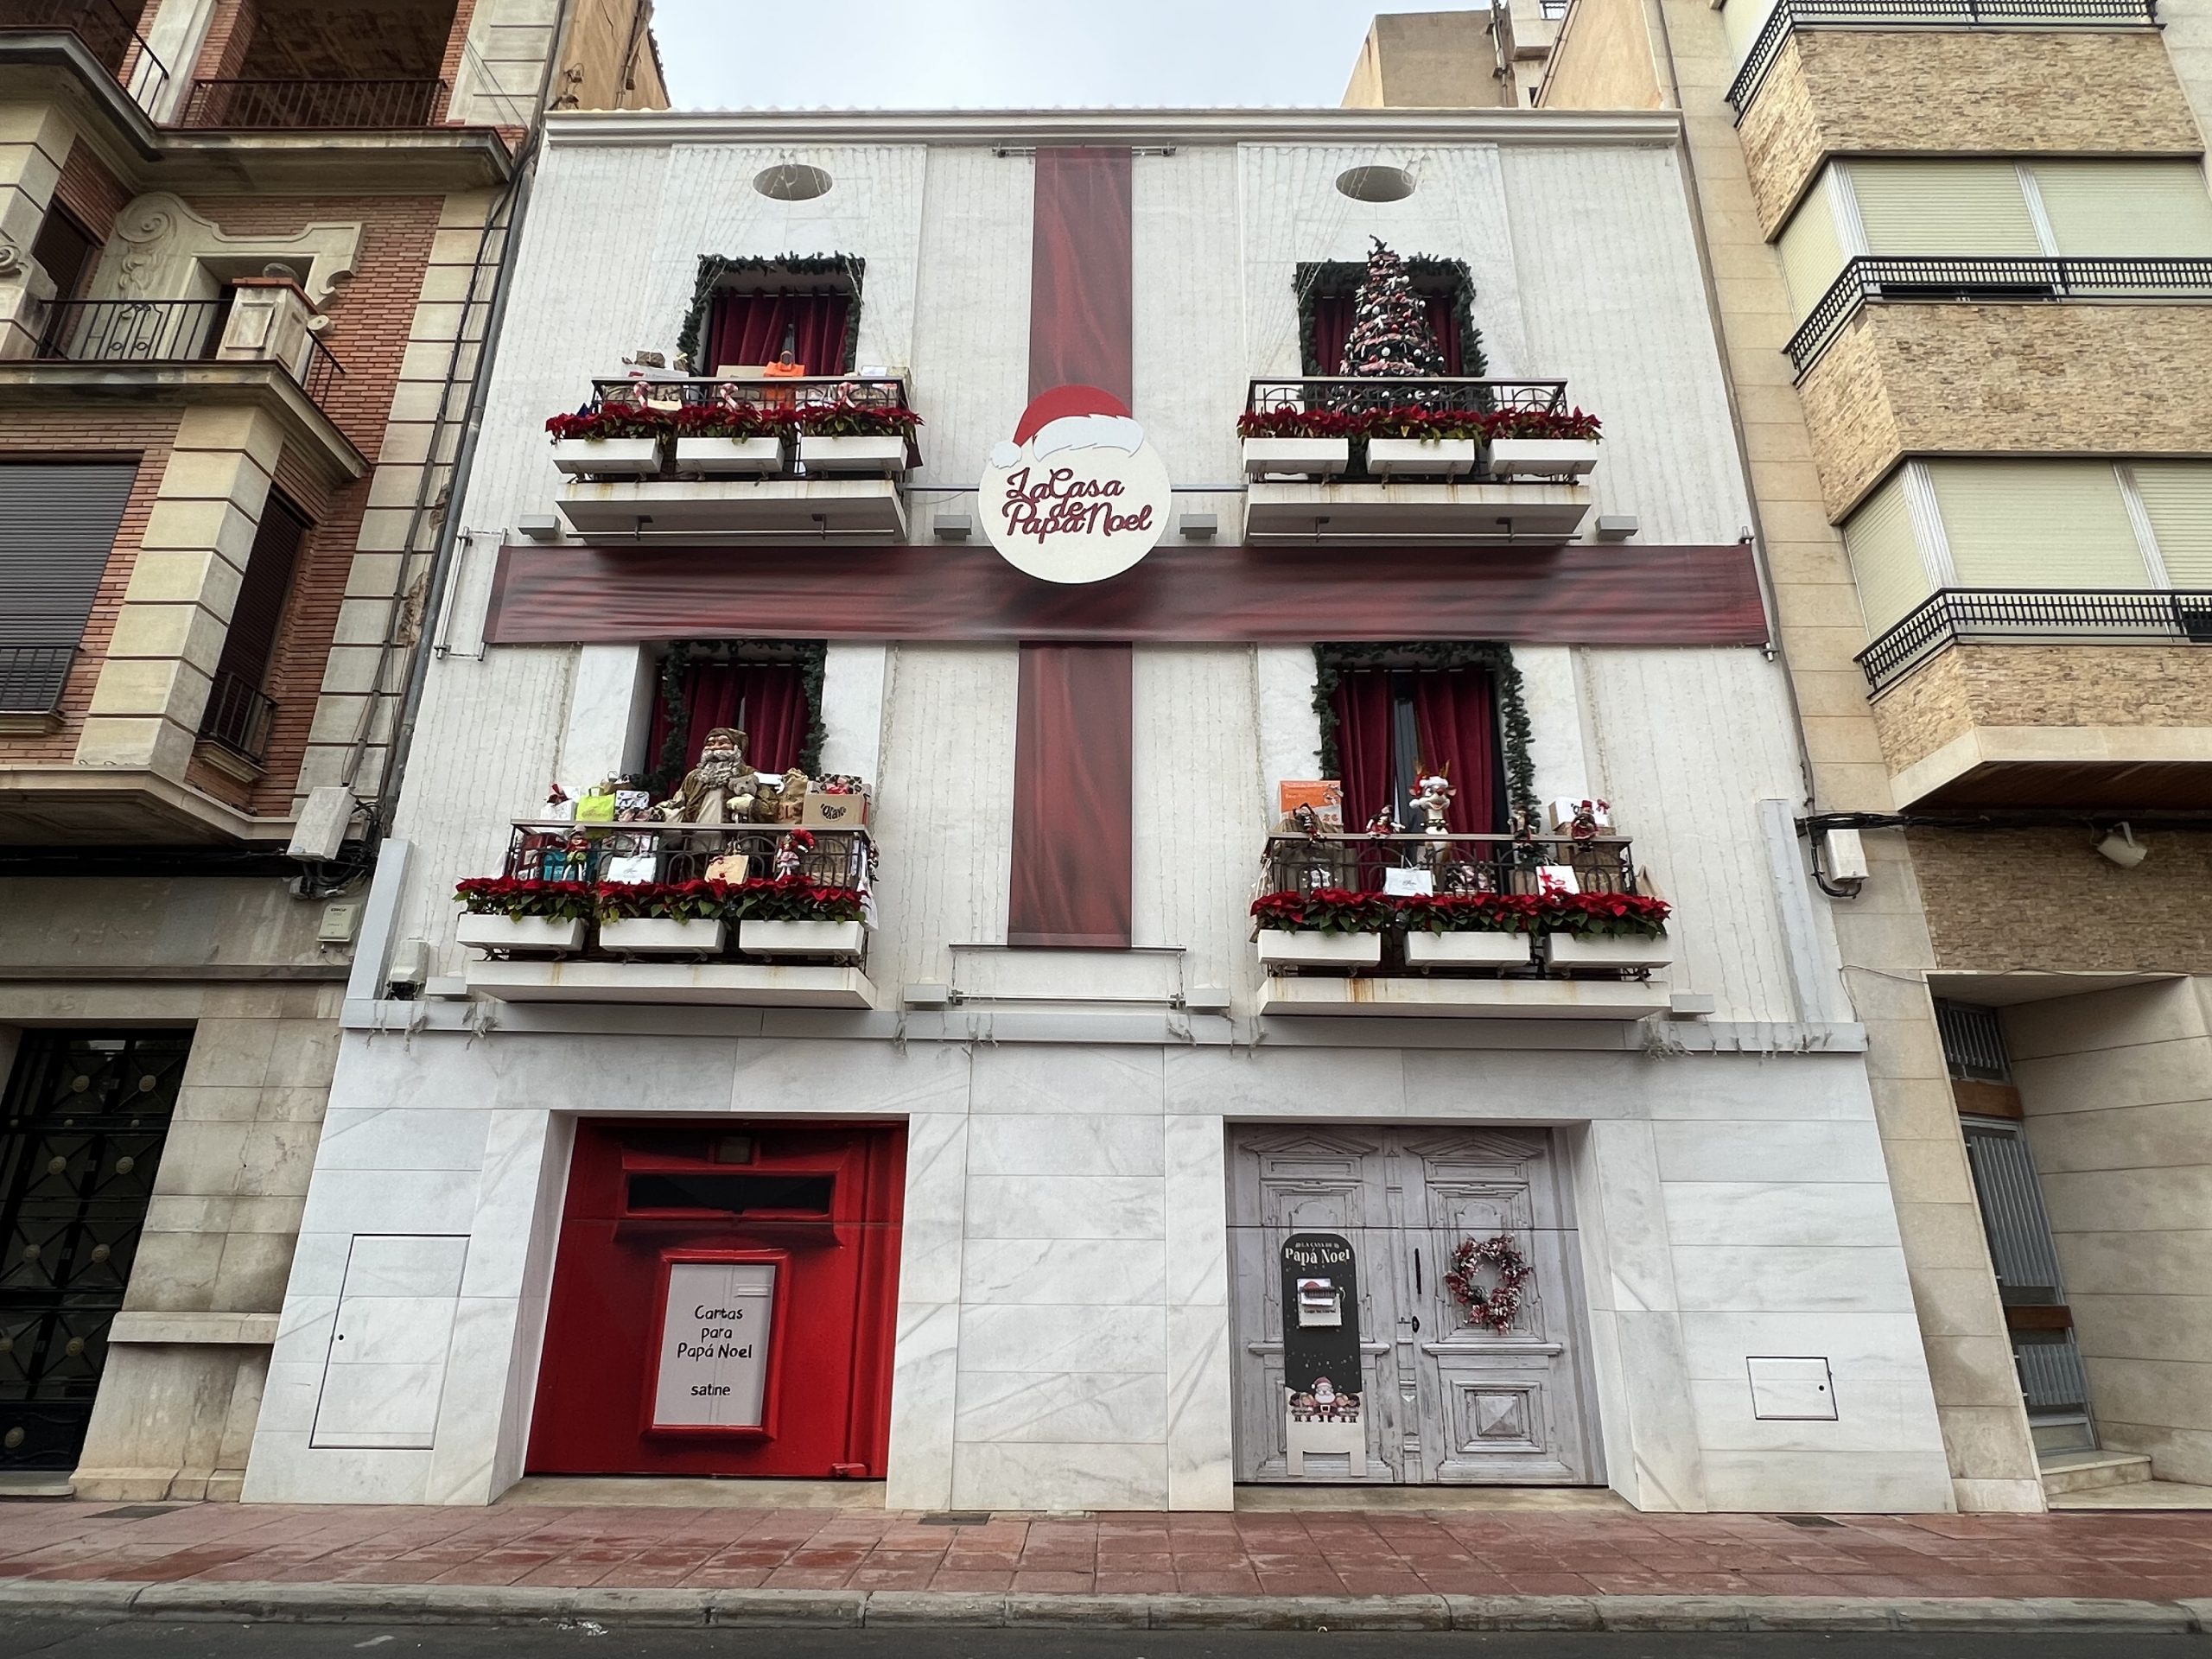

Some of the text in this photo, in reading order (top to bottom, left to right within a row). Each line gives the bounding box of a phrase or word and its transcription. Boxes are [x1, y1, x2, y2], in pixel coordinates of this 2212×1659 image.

[1049, 468, 1125, 499] Casa
[1049, 495, 1087, 520] de
[1086, 501, 1153, 537] Noel
[1285, 1247, 1351, 1266] Papá Noel
[695, 1305, 743, 1320] Cartas
[701, 1327, 733, 1343] para
[677, 1342, 753, 1362] Papá Noel
[690, 1383, 731, 1396] satine
